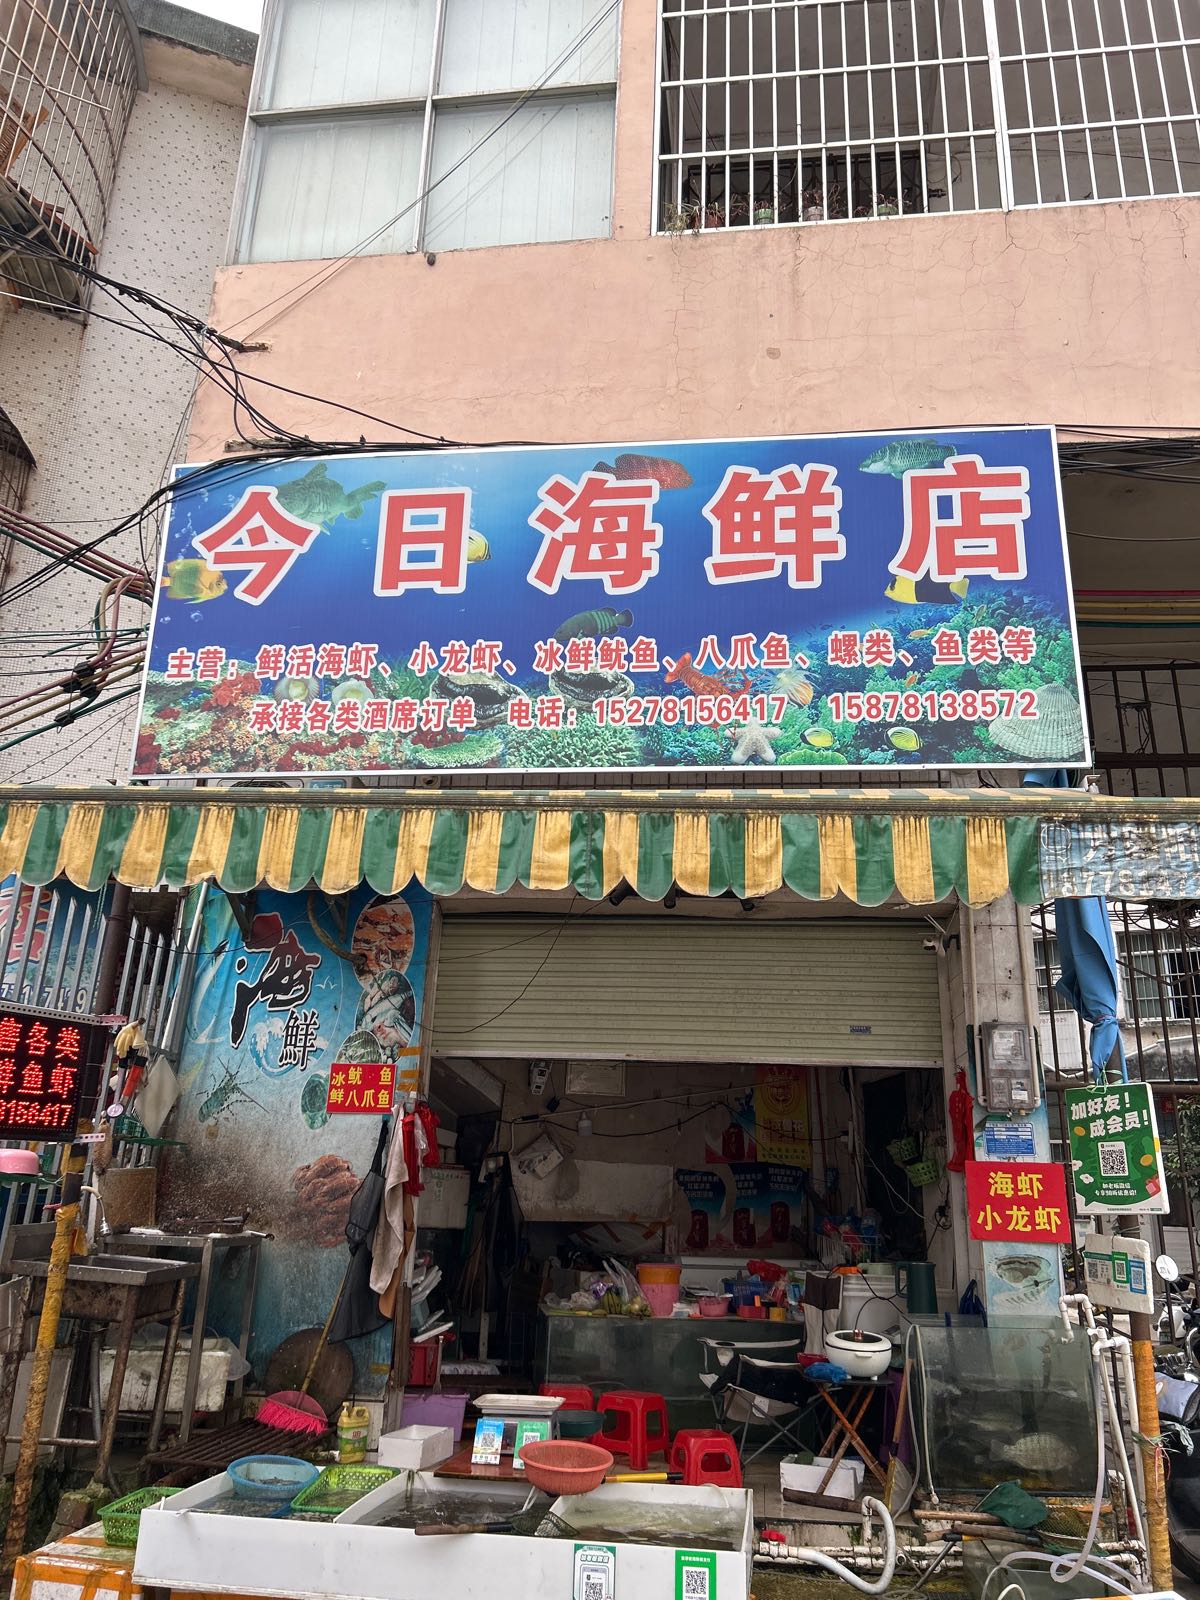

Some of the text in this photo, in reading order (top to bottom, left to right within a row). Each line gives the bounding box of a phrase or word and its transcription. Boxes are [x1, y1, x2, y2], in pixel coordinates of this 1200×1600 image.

[194, 455, 1031, 605] 今日海鲜店
[249, 696, 477, 734] 承接各类酒席订单
[828, 690, 1039, 722] 15878138572
[1071, 1092, 1130, 1121] 加好友！
[1090, 1109, 1149, 1138] 成会员！
[988, 1171, 1044, 1199] 海虾
[977, 1204, 1061, 1234] 小龙虾
